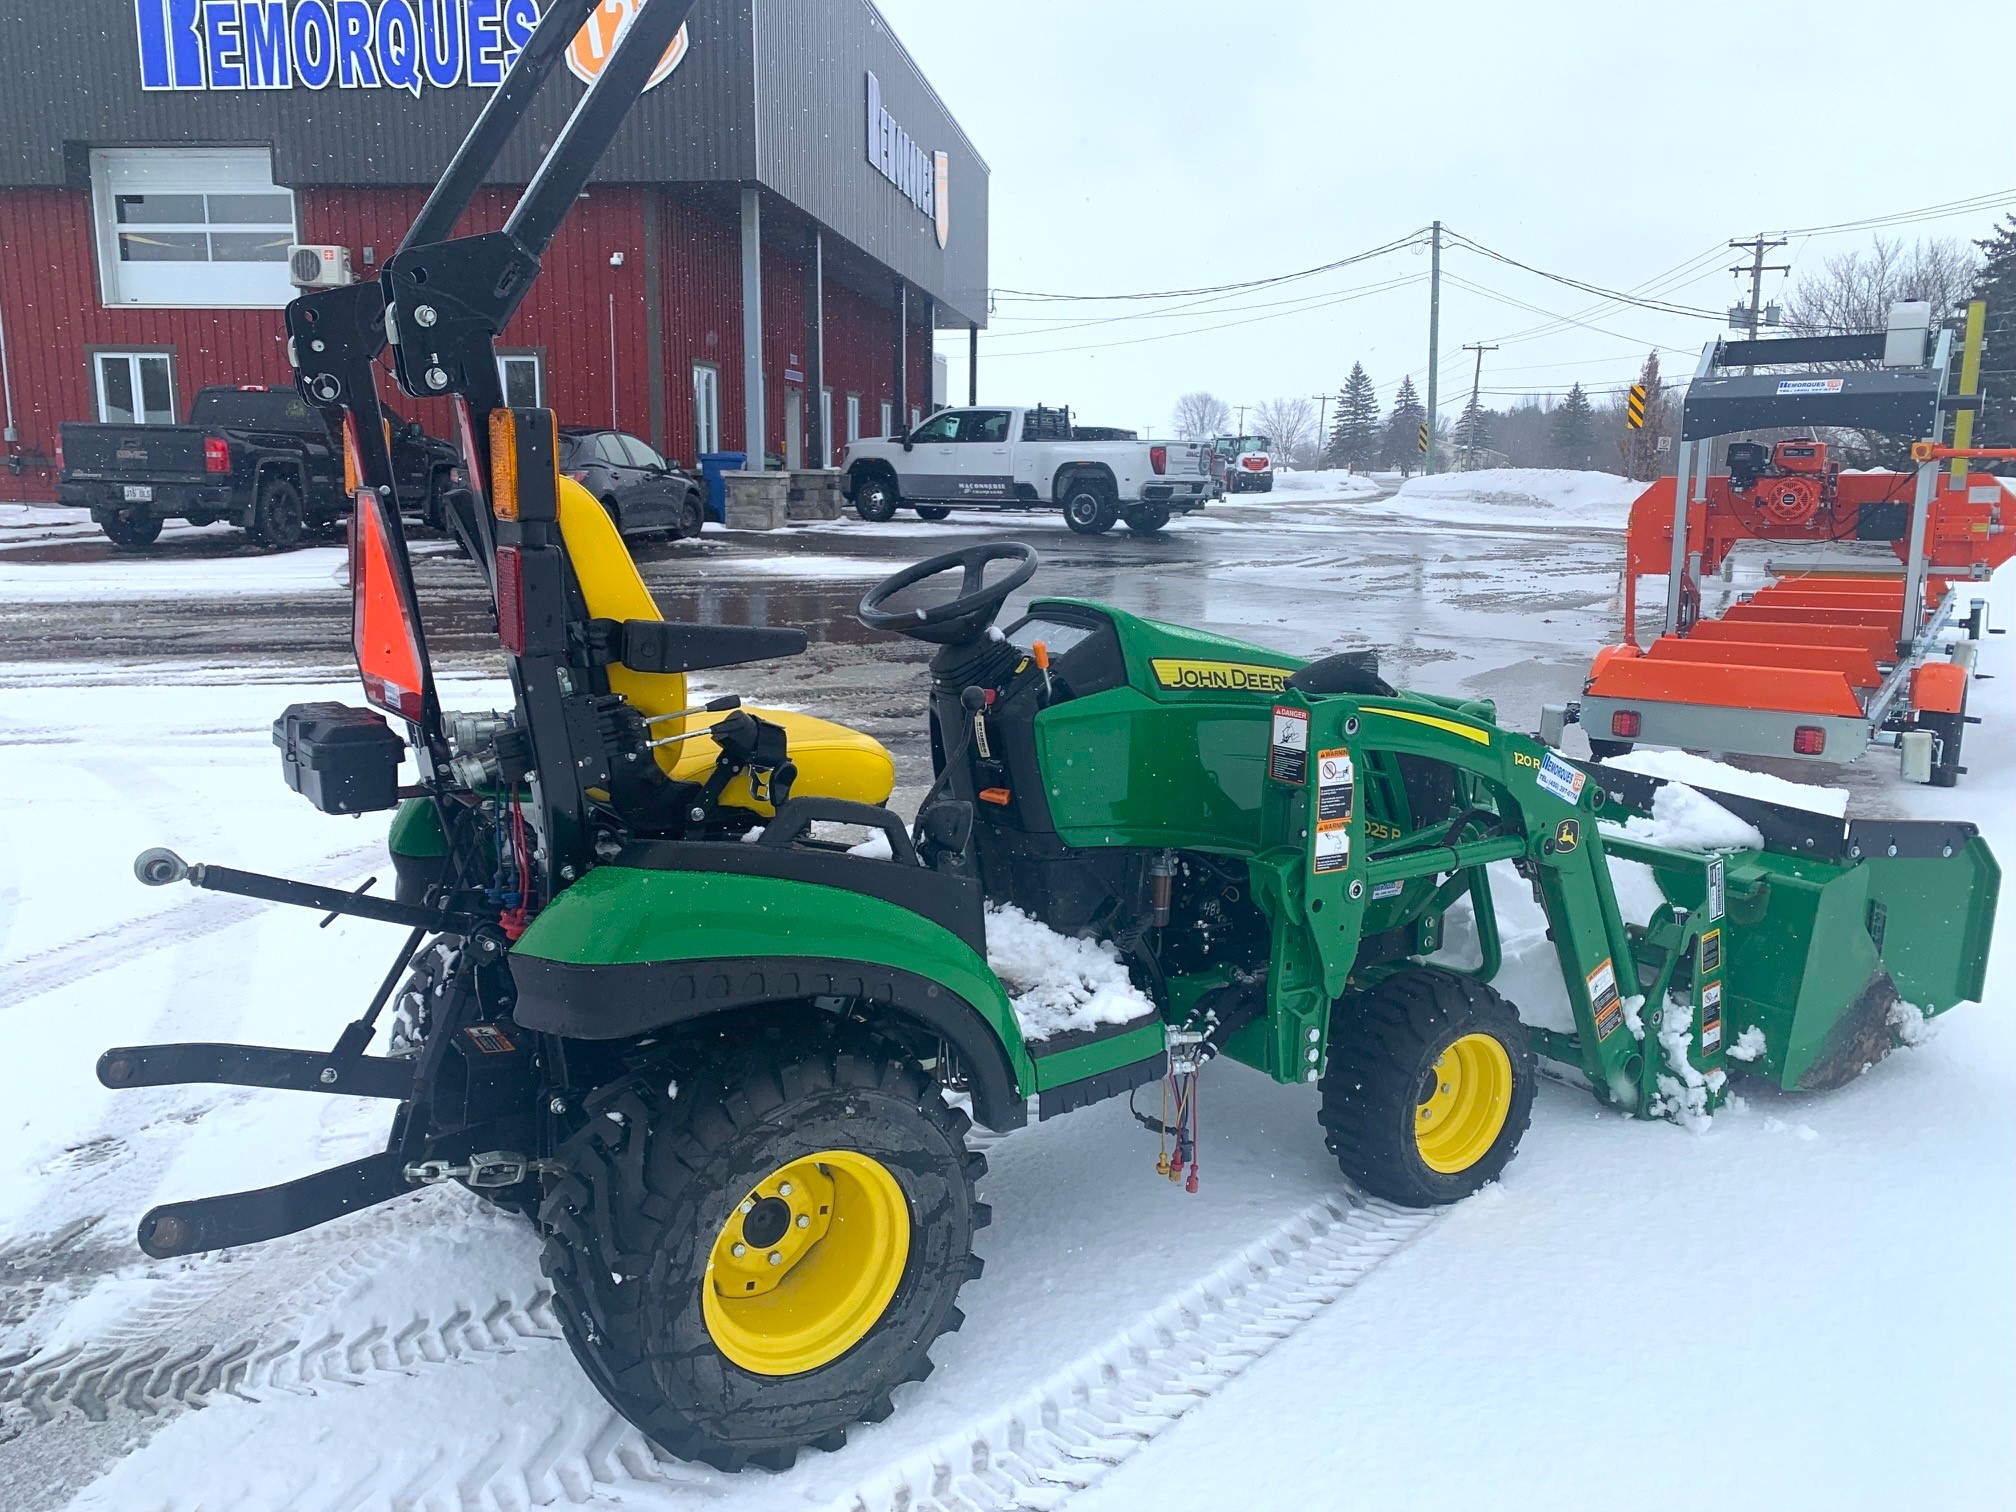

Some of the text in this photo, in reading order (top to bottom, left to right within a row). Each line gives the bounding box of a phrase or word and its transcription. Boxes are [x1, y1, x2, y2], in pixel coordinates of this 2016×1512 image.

[116, 450, 148, 459] GMC
[1172, 666, 1228, 687] JOHN
[1281, 708, 1307, 720] DANGER
[1325, 749, 1348, 758] WARNIN
[1513, 751, 1541, 770] 120 R
